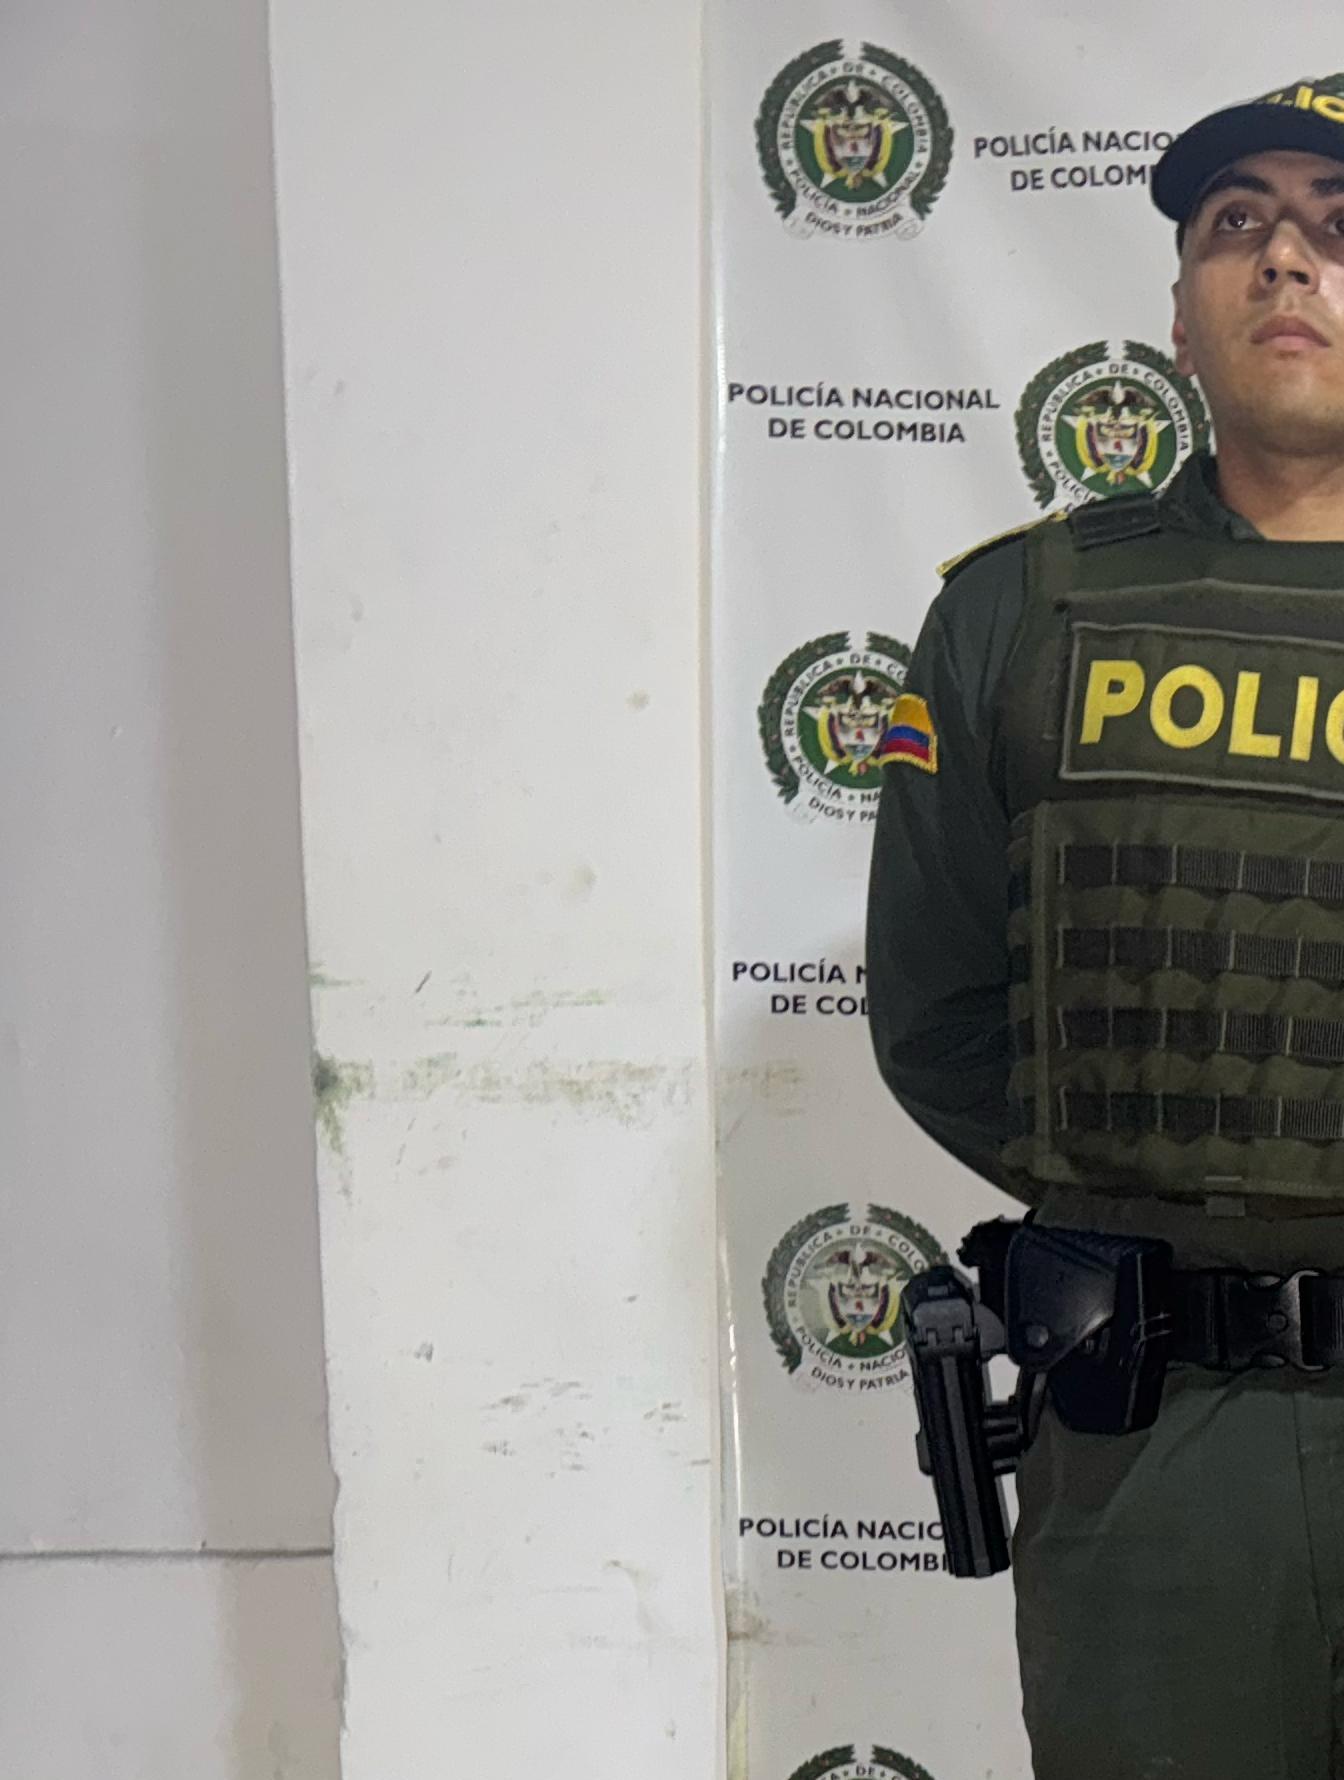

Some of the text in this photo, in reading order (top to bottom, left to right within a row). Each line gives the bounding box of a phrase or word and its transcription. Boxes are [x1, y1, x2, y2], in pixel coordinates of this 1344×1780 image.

[973, 126, 1182, 159] POLICÍA NACIO
[1011, 164, 1156, 191] DE COLOM
[728, 382, 1000, 411] POLICÍA NACIONAL
[768, 418, 966, 443] DE COLOMBIA
[732, 957, 846, 984] POLICÍA
[771, 994, 807, 1014] DE
[888, 1234, 926, 1271] COLO
[860, 1350, 906, 1372] NACIO
[738, 1514, 944, 1541] POLICÍA NACIO
[777, 1550, 948, 1572] DE COLOMBI
